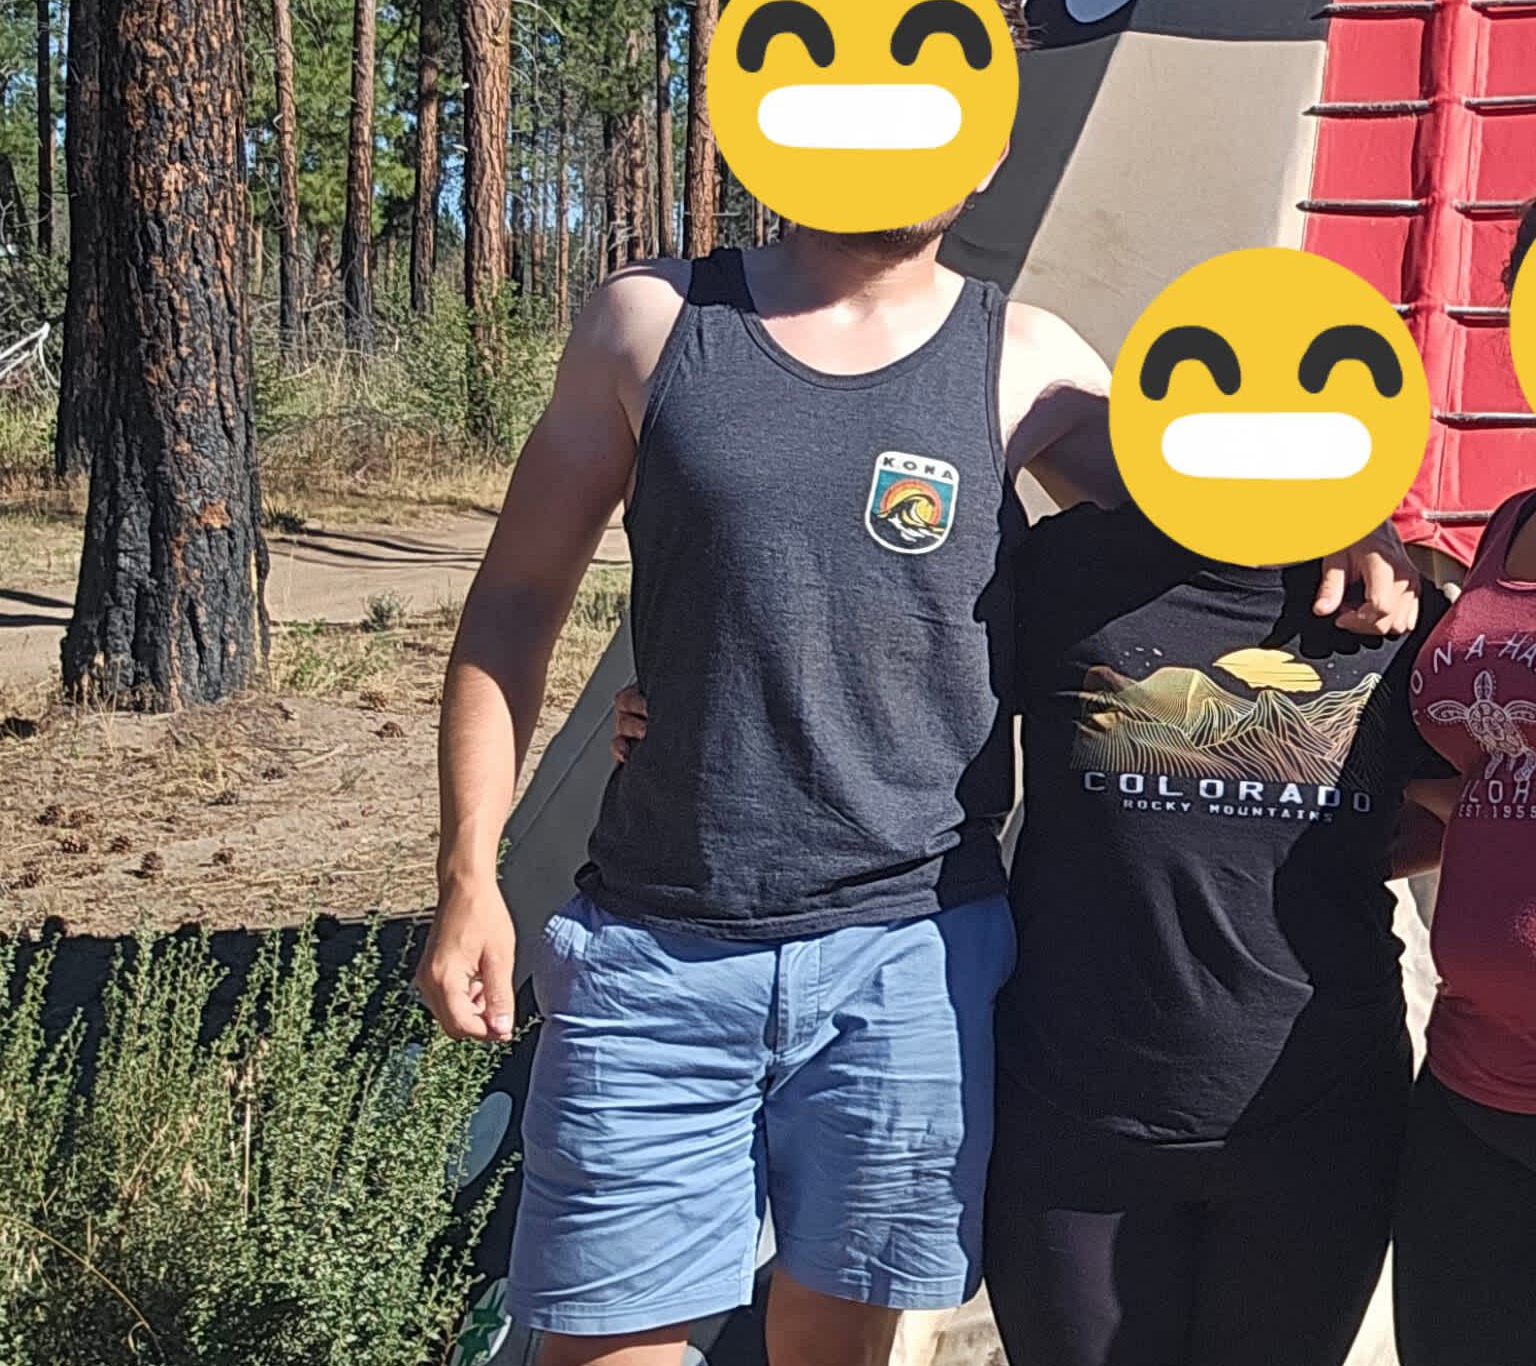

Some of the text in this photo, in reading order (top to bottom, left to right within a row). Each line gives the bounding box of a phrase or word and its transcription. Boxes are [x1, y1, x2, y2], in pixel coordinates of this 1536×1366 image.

[883, 457, 953, 480] KONA
[1084, 772, 1370, 812] COLORADO
[1123, 799, 1333, 822] ROCKY MOUNTAINS
